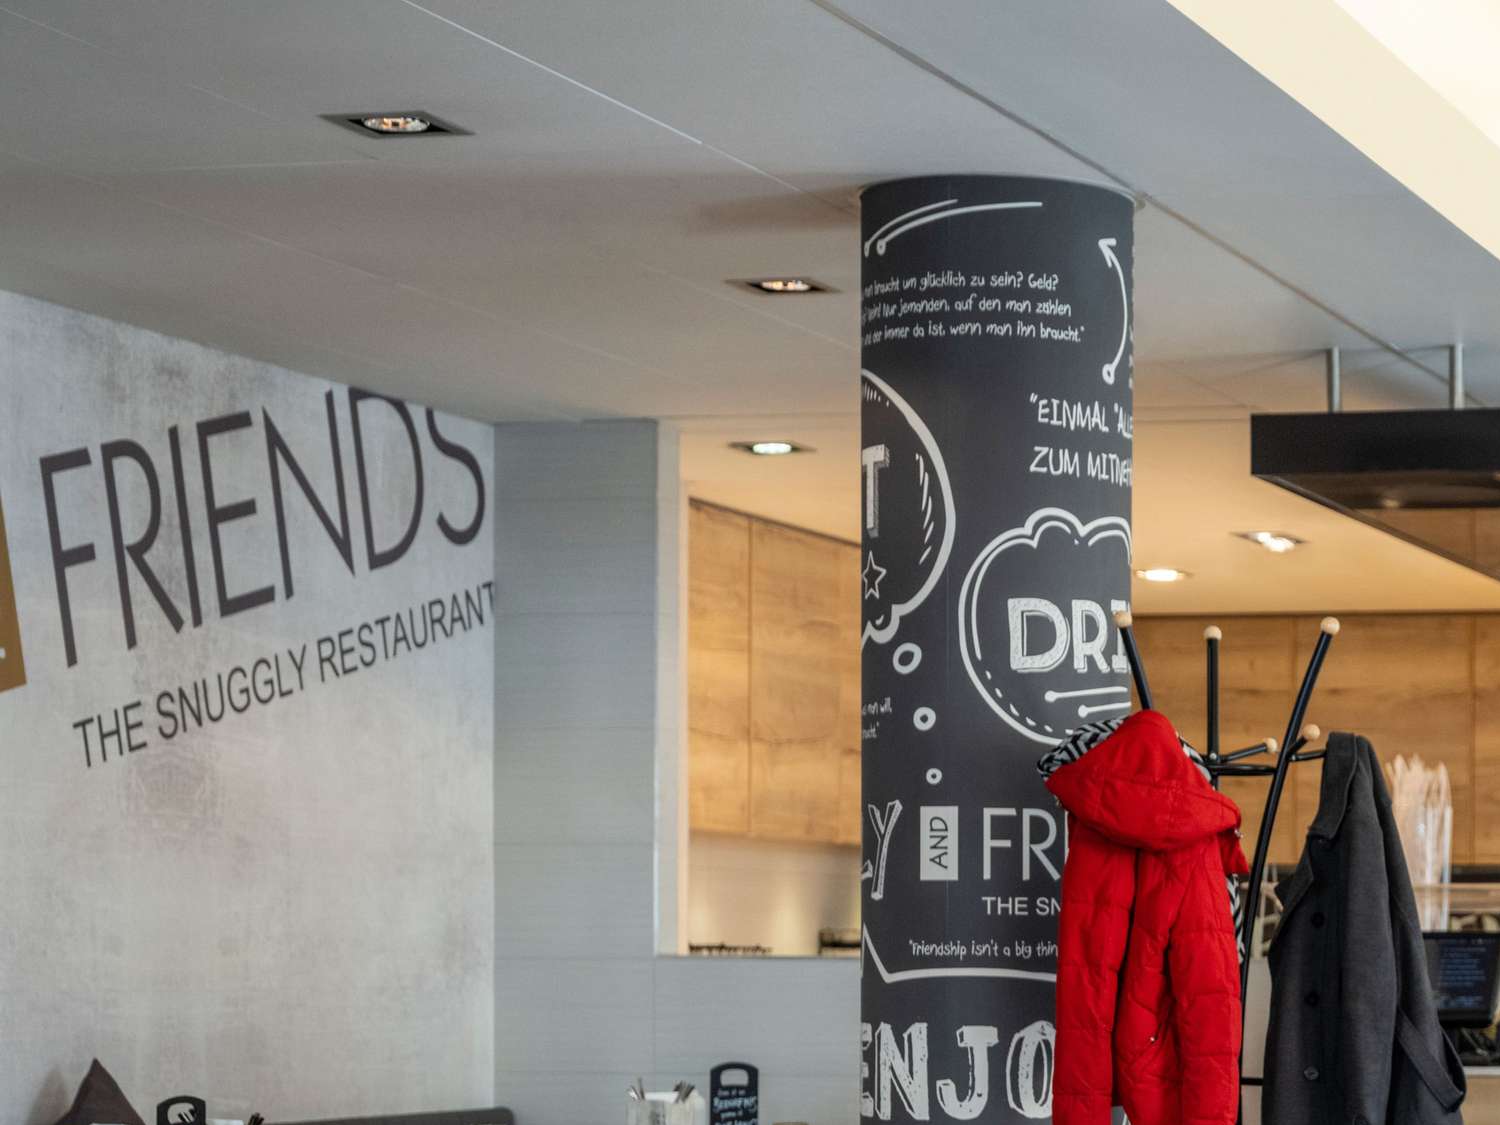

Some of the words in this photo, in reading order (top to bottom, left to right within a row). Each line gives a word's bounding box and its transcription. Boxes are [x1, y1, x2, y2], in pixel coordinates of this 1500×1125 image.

[902, 277, 917, 290] um
[920, 270, 966, 291] glücklich
[970, 275, 985, 287] zu
[990, 271, 1024, 288] sein?
[1027, 273, 1059, 291] Geld?
[954, 293, 978, 312] auf
[979, 297, 1001, 312] den
[1005, 299, 1031, 313] man
[1035, 299, 1071, 317] zählen
[912, 323, 924, 338] da
[950, 322, 981, 336] wenn
[986, 323, 1012, 336] man
[1017, 320, 1036, 338] ihn
[1029, 446, 1080, 478] ZUM
[38, 385, 486, 669] FRIENDS
[1007, 597, 1130, 673] DRI
[73, 701, 148, 768] THE
[156, 643, 308, 740] SNUGGLY
[317, 580, 494, 683] RESTAURANT
[929, 816, 949, 869] AND
[983, 807, 1061, 882] FR
[982, 896, 1029, 916] THE
[1035, 896, 1062, 916] SN
[971, 938, 999, 957] isn't
[1003, 946, 1011, 957] a
[1015, 939, 1032, 960] big
[1037, 940, 1058, 958] thin
[861, 1020, 1056, 1121] ENJO
